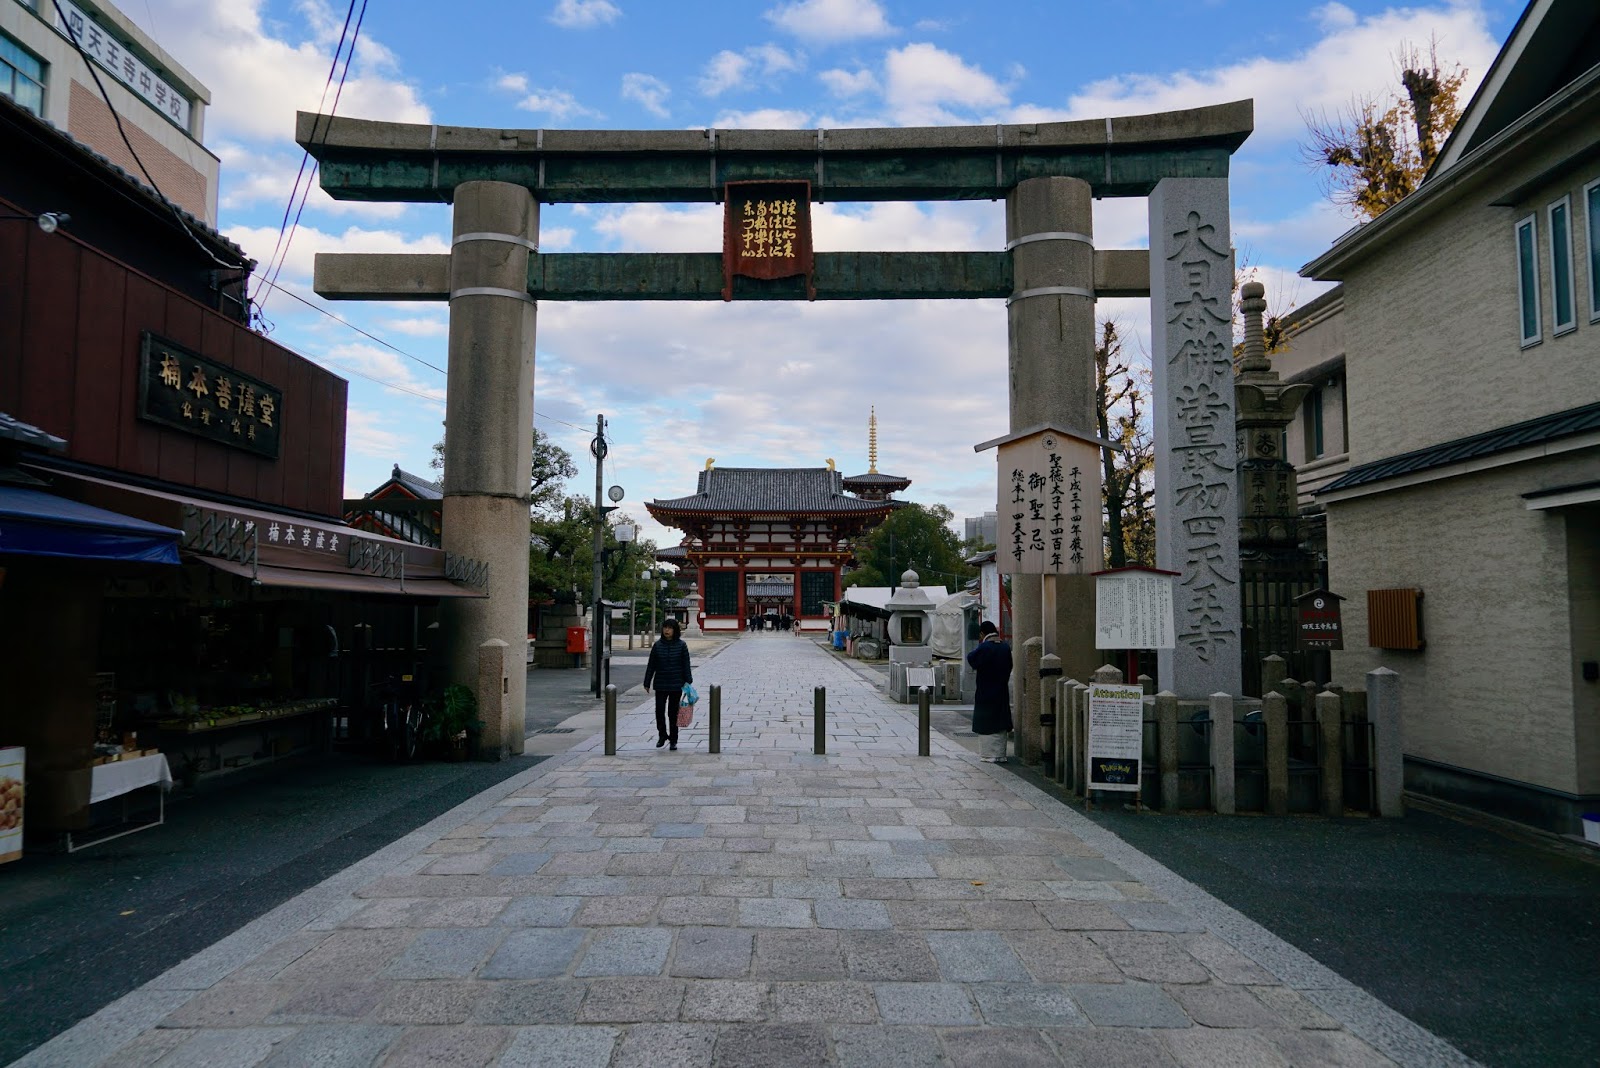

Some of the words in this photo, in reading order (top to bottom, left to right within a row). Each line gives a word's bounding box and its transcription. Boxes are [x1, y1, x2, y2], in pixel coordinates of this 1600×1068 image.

[69, 9, 182, 121] 四天王寺中学校
[1048, 453, 1064, 572] 聖徳太子千四百年
[1093, 688, 1141, 700] Attention
